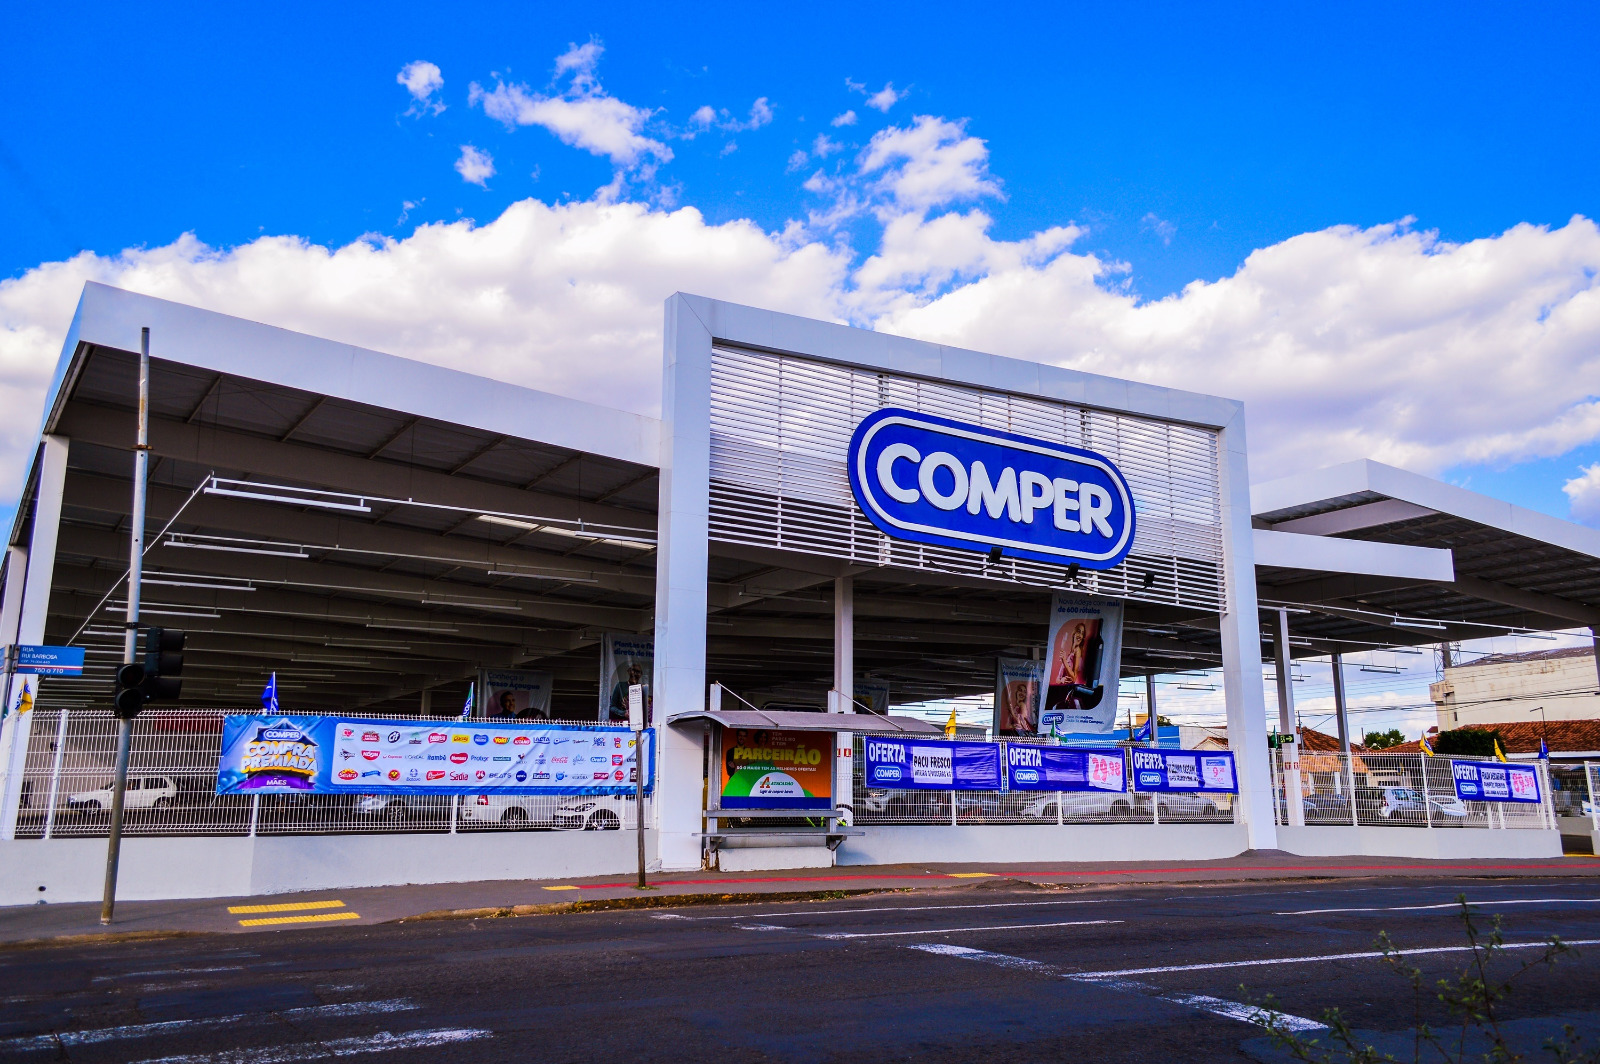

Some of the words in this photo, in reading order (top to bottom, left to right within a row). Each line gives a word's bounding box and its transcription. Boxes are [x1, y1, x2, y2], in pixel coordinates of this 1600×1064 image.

[876, 442, 1114, 539] COMPER
[509, 682, 540, 690] Açougue
[266, 730, 300, 739] COMPER
[245, 741, 315, 759] COMPRA
[733, 744, 822, 766] PARCEIRÃO
[868, 742, 906, 763] OFERTA
[1009, 747, 1042, 767] OFERTA
[241, 755, 318, 773] PREMIADA
[913, 755, 929, 768] PACU
[930, 756, 951, 769] FRESCO
[1134, 751, 1165, 770] OFERTA
[876, 769, 900, 778] COMPER
[1016, 771, 1038, 781] COMPER
[1141, 775, 1160, 783] COMPER
[1454, 764, 1479, 781] OFERTA
[266, 777, 287, 786] MÃES
